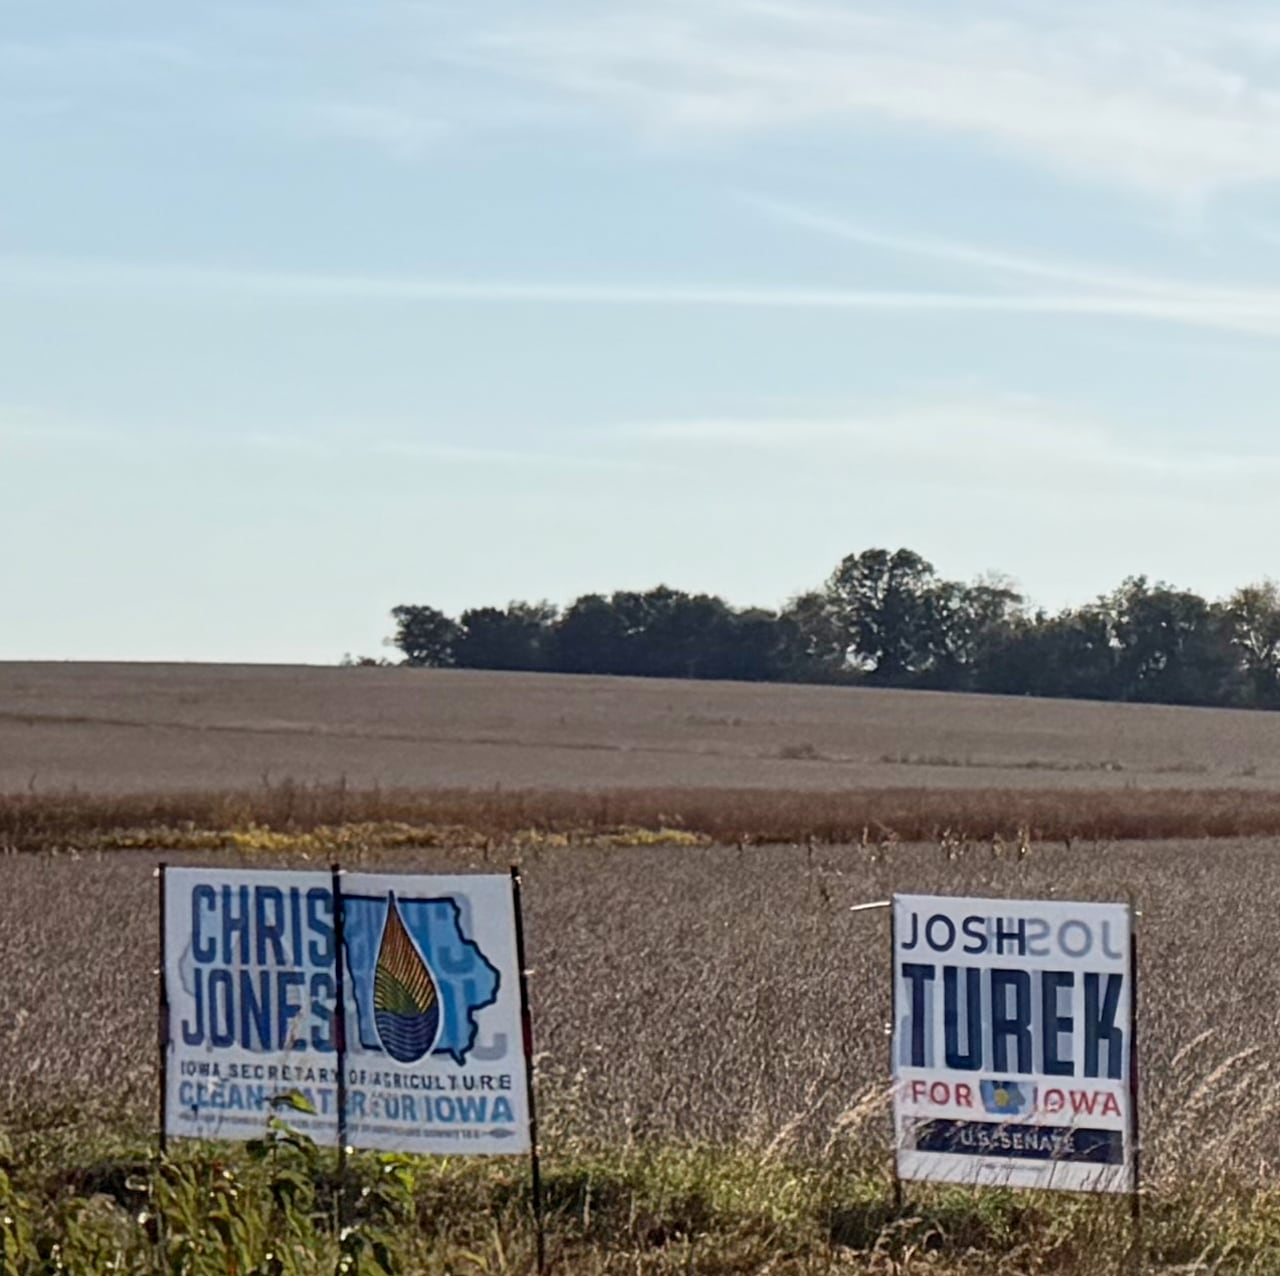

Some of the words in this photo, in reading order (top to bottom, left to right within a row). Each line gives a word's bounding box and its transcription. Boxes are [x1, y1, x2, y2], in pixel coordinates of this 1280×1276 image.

[191, 884, 337, 968] CHRIS
[901, 912, 1026, 956] JOSH
[181, 967, 338, 1052] JONES
[901, 963, 1124, 1080] TUREK
[180, 1060, 221, 1077] IOWA
[229, 1063, 340, 1083] SECRETARY
[350, 1069, 367, 1084] OF
[373, 1070, 512, 1090] AGRICULTURE
[179, 1080, 264, 1111] CLEAN
[424, 1095, 515, 1124] IOWA
[911, 1079, 973, 1108] FOR
[1032, 1085, 1122, 1117] IOWA
[1001, 1133, 1076, 1152] SENATE
